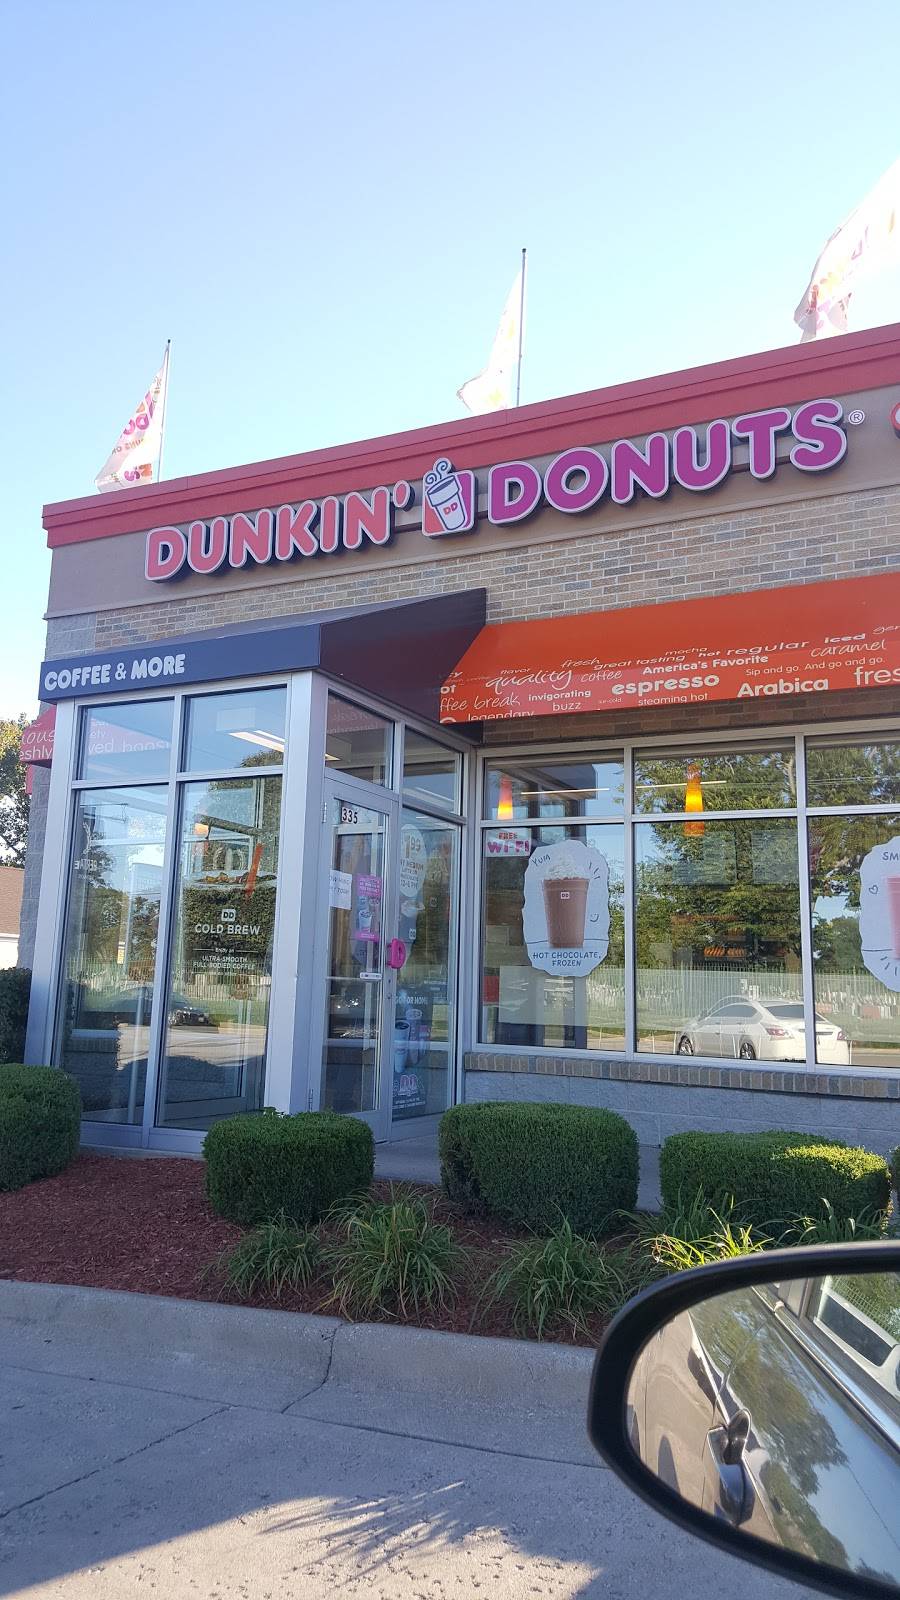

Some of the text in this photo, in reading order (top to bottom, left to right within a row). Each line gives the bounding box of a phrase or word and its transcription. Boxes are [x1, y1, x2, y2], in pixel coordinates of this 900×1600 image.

[145, 480, 410, 580] DUNKIN'
[487, 398, 849, 524] DONUTS
[726, 640, 810, 656] regular
[810, 639, 887, 657] caramel
[636, 655, 685, 665] tasting
[643, 655, 769, 675] America's Favorite
[745, 668, 761, 677] Sip
[764, 665, 783, 675] and
[805, 661, 825, 670] And
[829, 661, 842, 669] go
[845, 657, 866, 666] and
[44, 653, 186, 691] COFFEE & MORE
[581, 670, 622, 682] coffee
[486, 669, 572, 694] quality
[612, 674, 720, 697] espresso
[737, 678, 829, 698] Arabica
[474, 692, 520, 709] break
[528, 689, 591, 702] invigorating
[638, 692, 708, 706] steaming hot
[553, 701, 582, 711] buzz
[341, 808, 358, 824] 335
[531, 853, 551, 867] YUM
[223, 911, 235, 919] DD
[194, 923, 261, 935] COLD BREW
